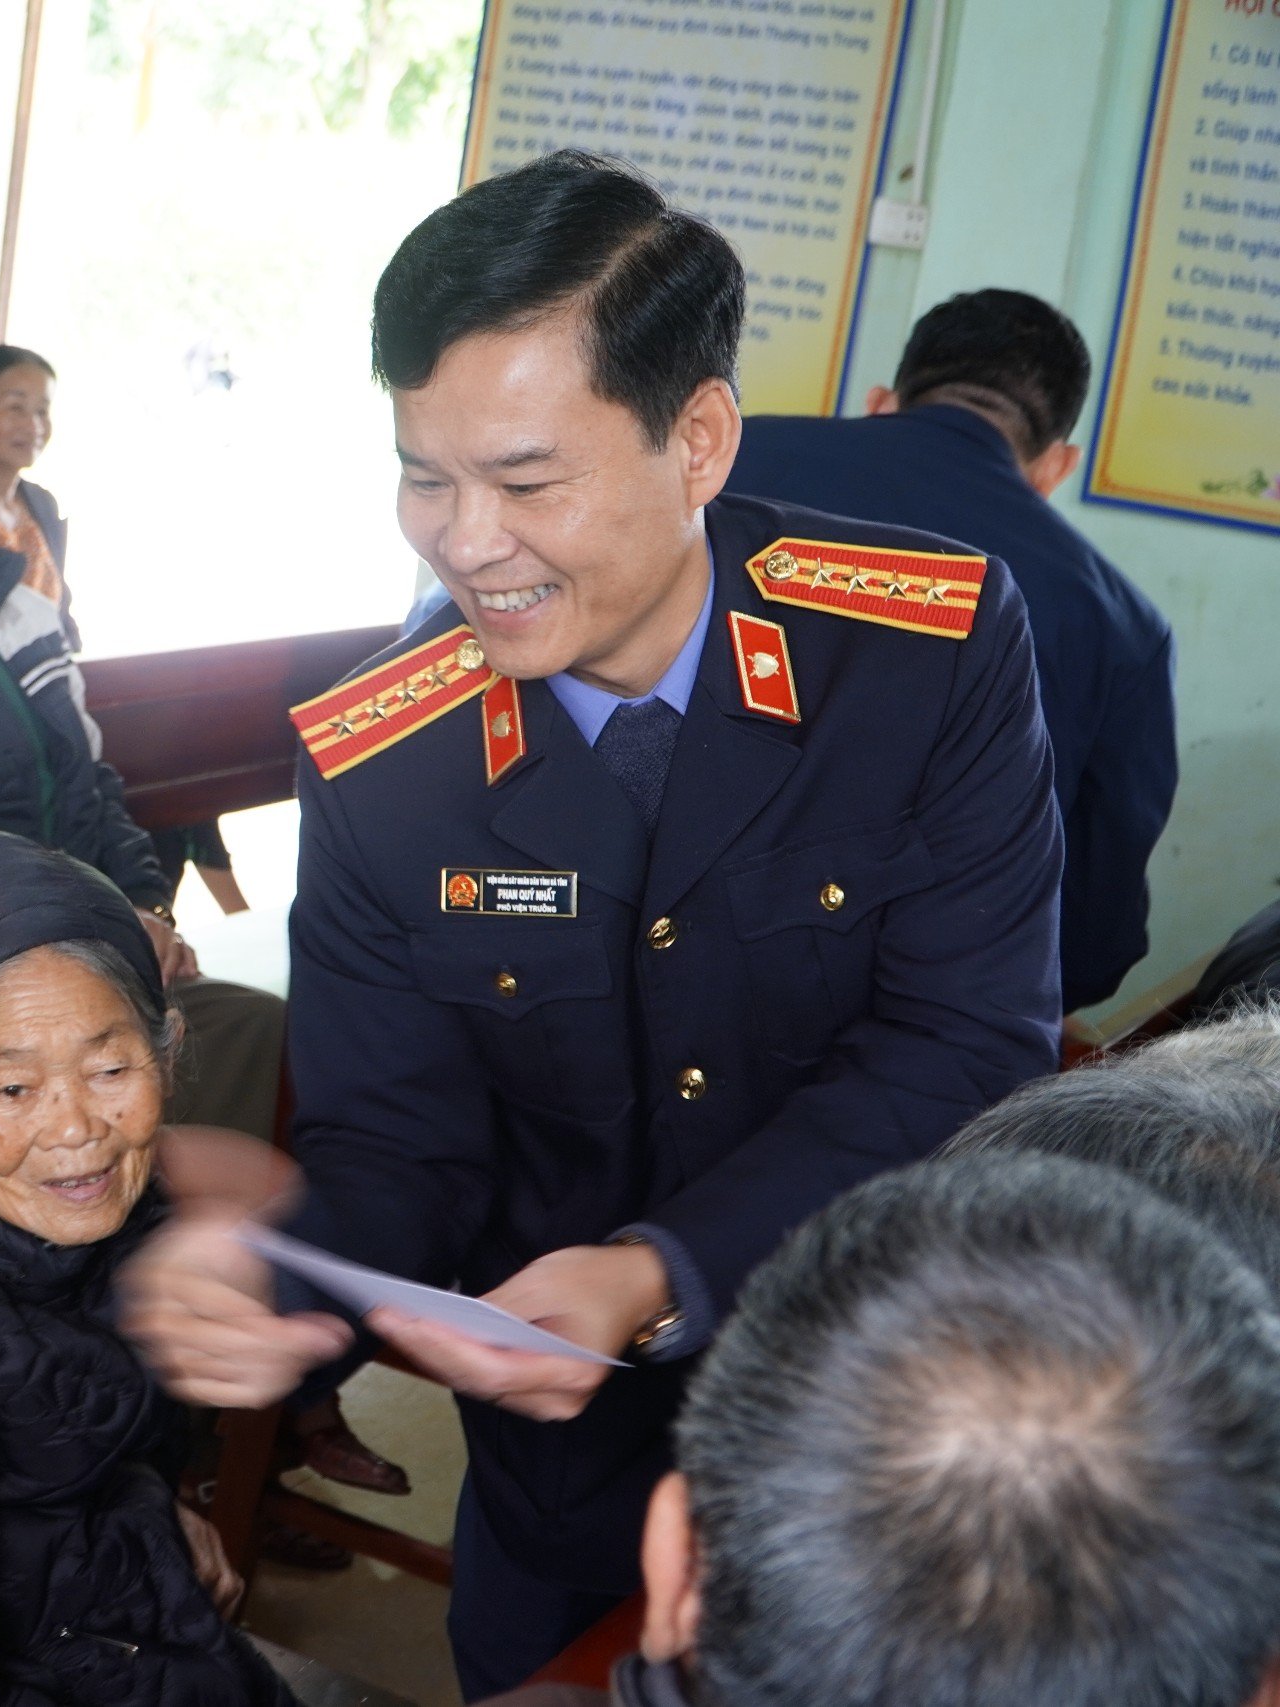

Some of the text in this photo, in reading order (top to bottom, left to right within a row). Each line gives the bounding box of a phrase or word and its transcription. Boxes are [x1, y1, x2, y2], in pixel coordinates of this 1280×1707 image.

[1254, 125, 1280, 146] nha
[497, 886, 557, 902] PHAN QUÝ NHẤT
[496, 902, 512, 912] PHÓ
[512, 903, 528, 913] VIỆN
